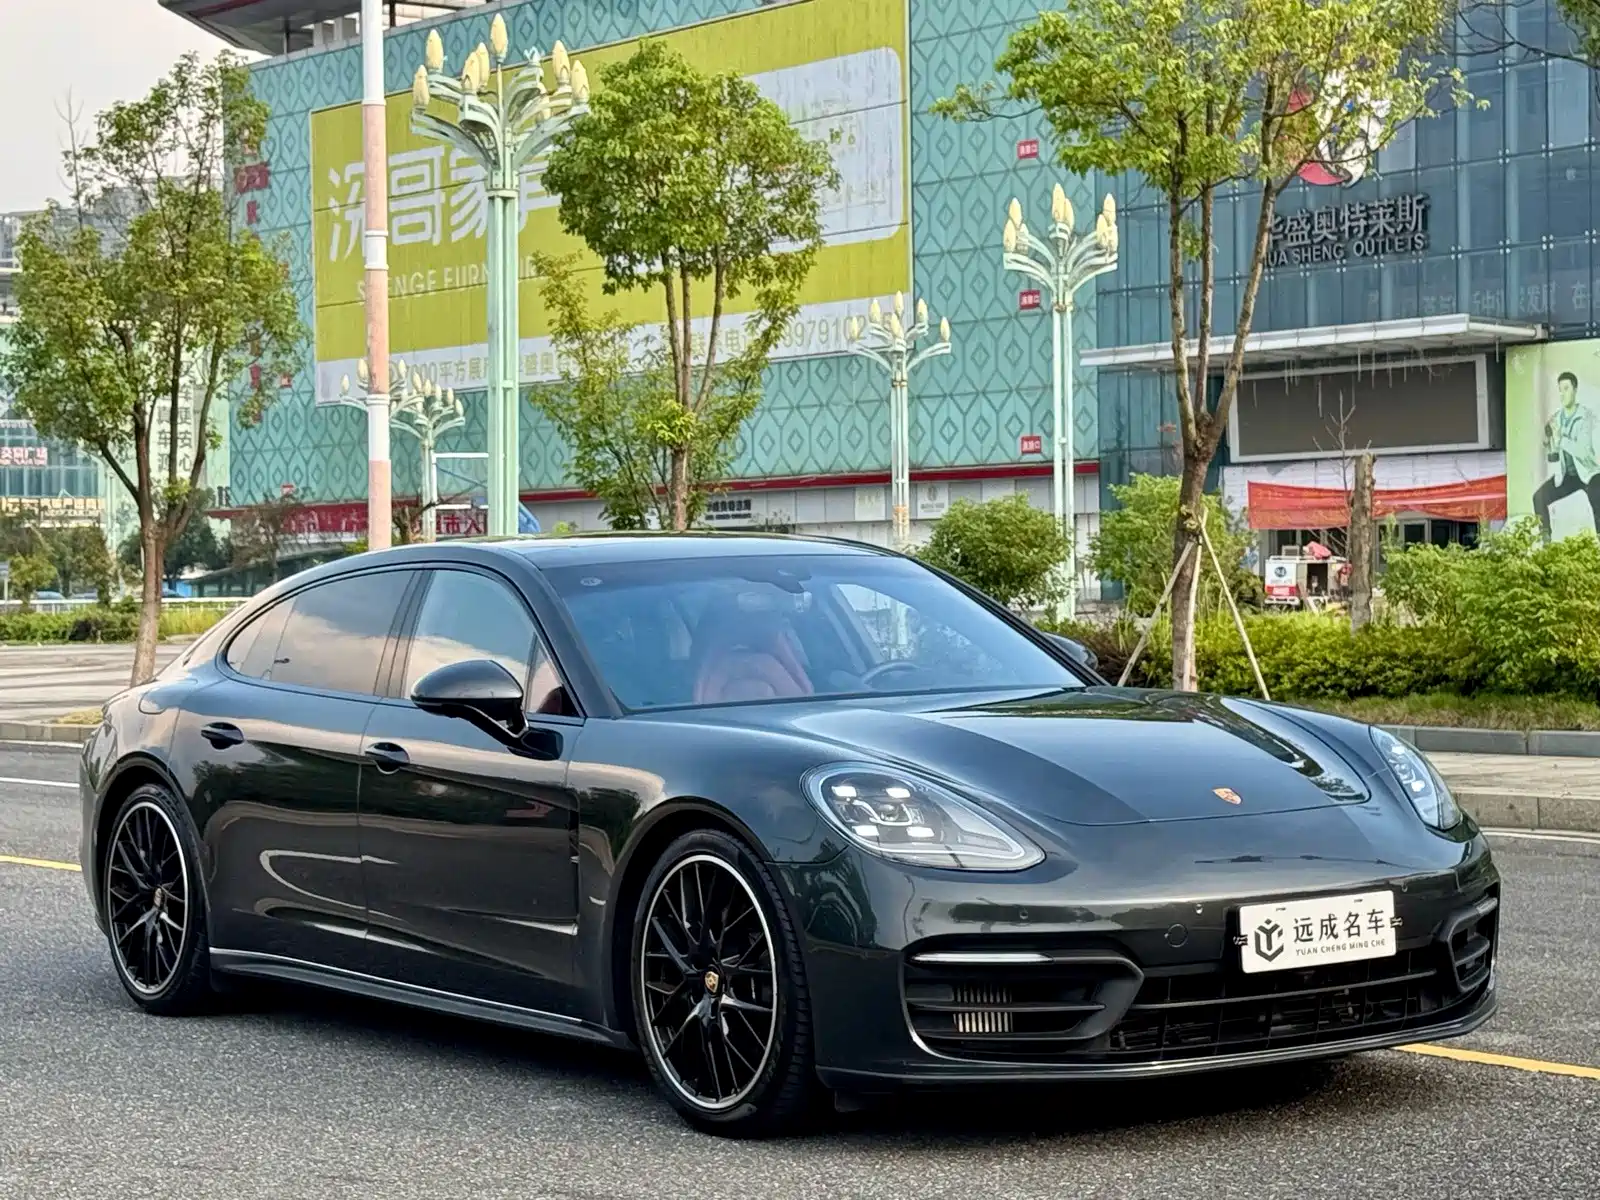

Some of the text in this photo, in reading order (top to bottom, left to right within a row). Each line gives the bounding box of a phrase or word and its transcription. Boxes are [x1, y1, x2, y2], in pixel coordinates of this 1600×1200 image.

[1291, 243, 1345, 264] SHENG
[1353, 232, 1425, 257] OUTLETS
[356, 269, 437, 306] SNGE
[1293, 908, 1386, 943] 远成名车
[1295, 938, 1386, 956] YUAN CHENG MING CHE
